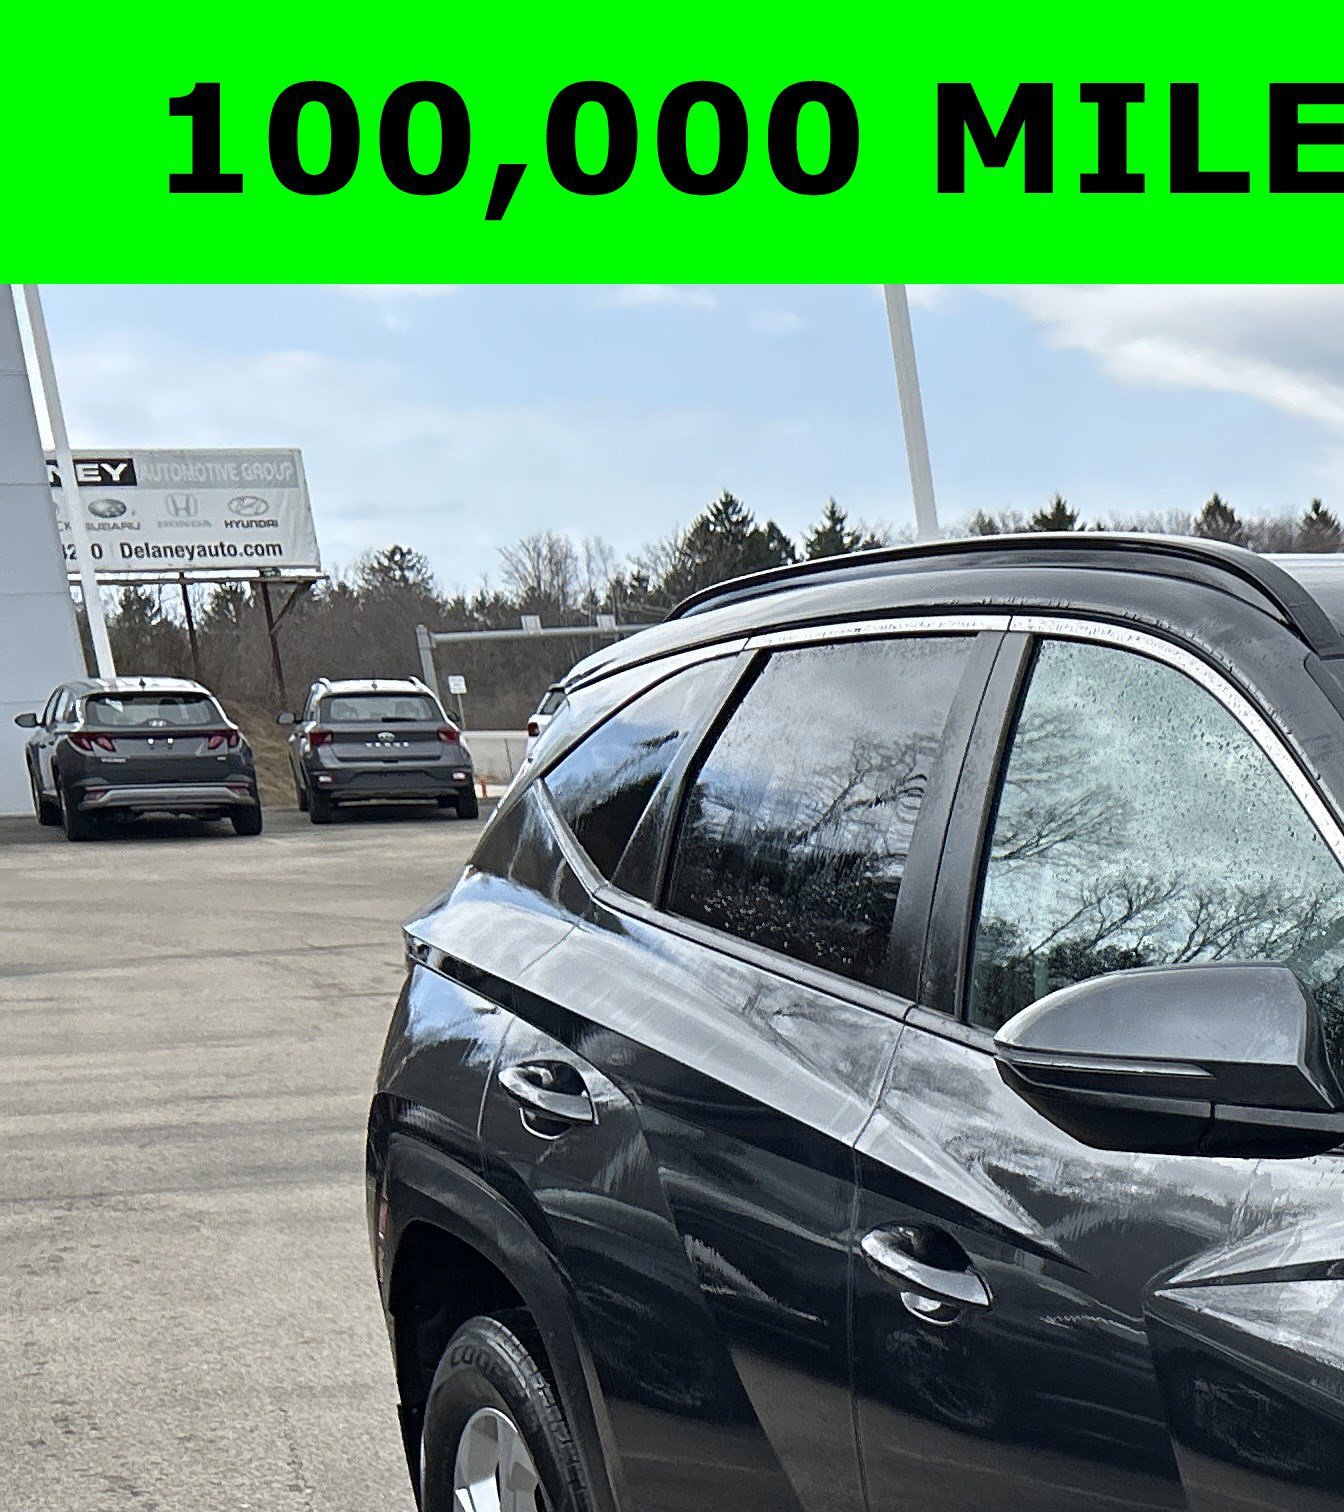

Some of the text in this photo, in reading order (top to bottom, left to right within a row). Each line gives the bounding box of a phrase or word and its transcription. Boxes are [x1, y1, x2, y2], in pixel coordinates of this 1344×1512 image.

[241, 460, 293, 481] GROUP
[224, 518, 279, 529] HYUNDAI
[119, 541, 283, 561] Delaneyauto.com
